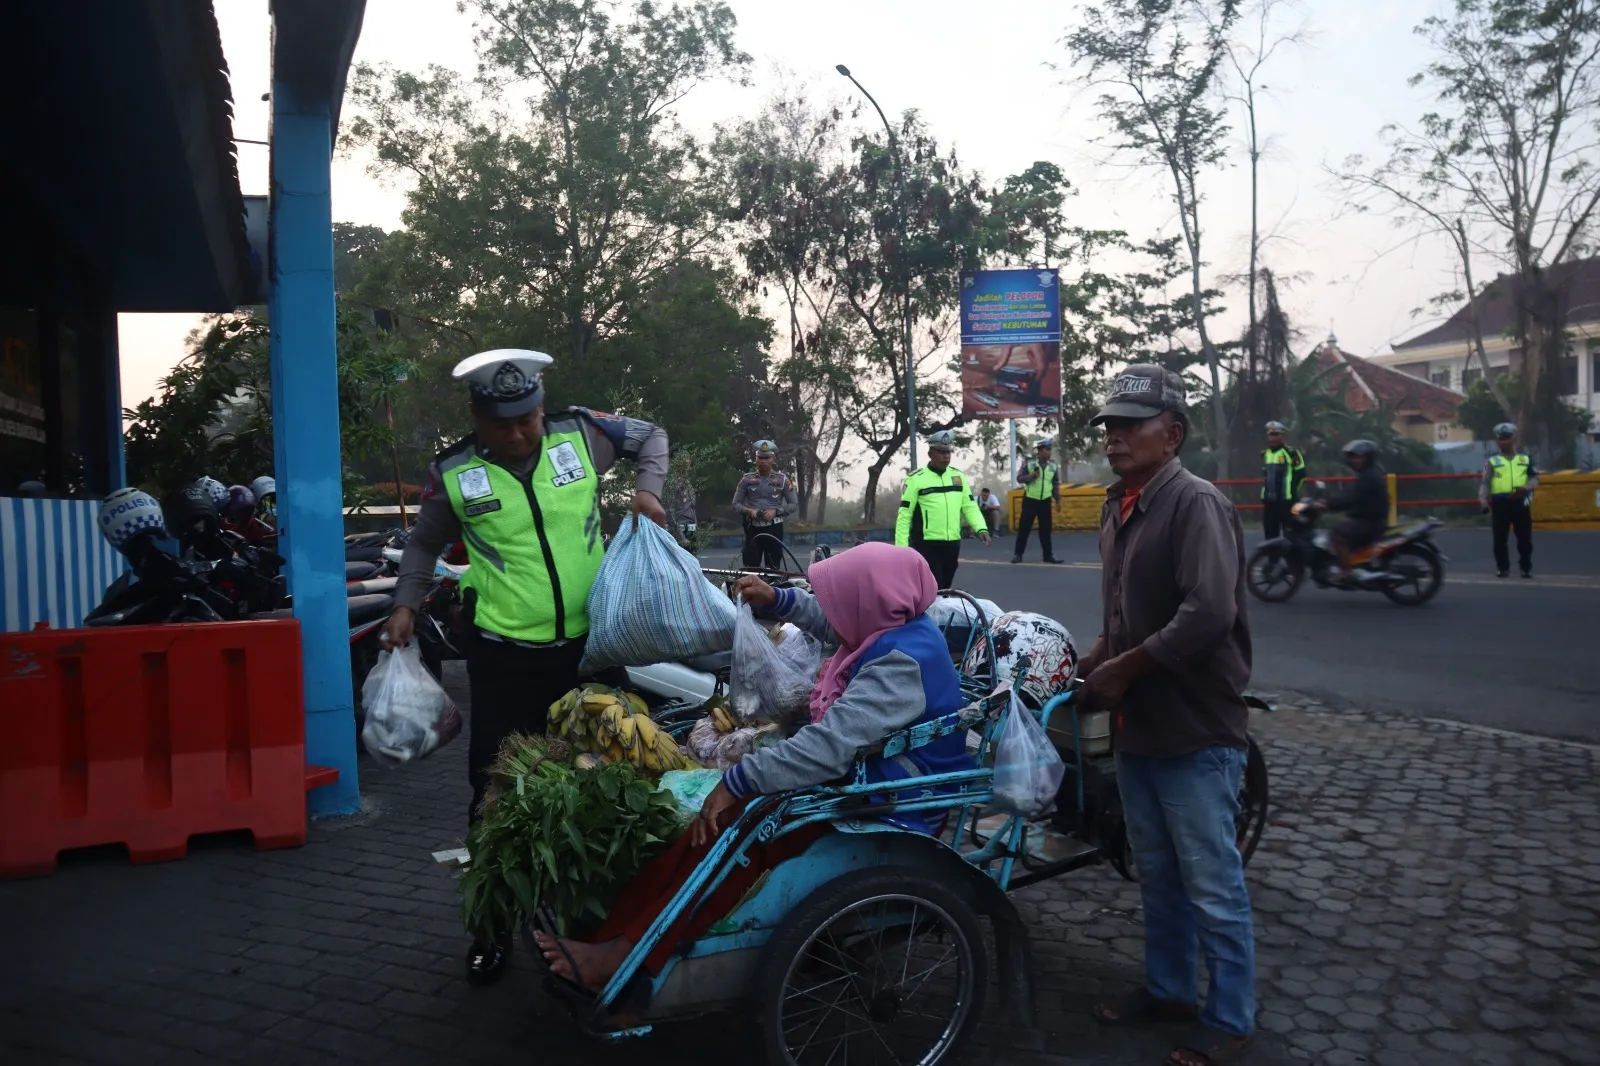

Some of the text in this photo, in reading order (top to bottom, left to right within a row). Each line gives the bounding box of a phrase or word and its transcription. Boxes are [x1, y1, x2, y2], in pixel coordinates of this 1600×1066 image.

[974, 291, 1044, 302] Jadilah PELOPOR
[1002, 321, 1048, 329] KEBUTUHAN
[110, 498, 149, 519] POLISI
